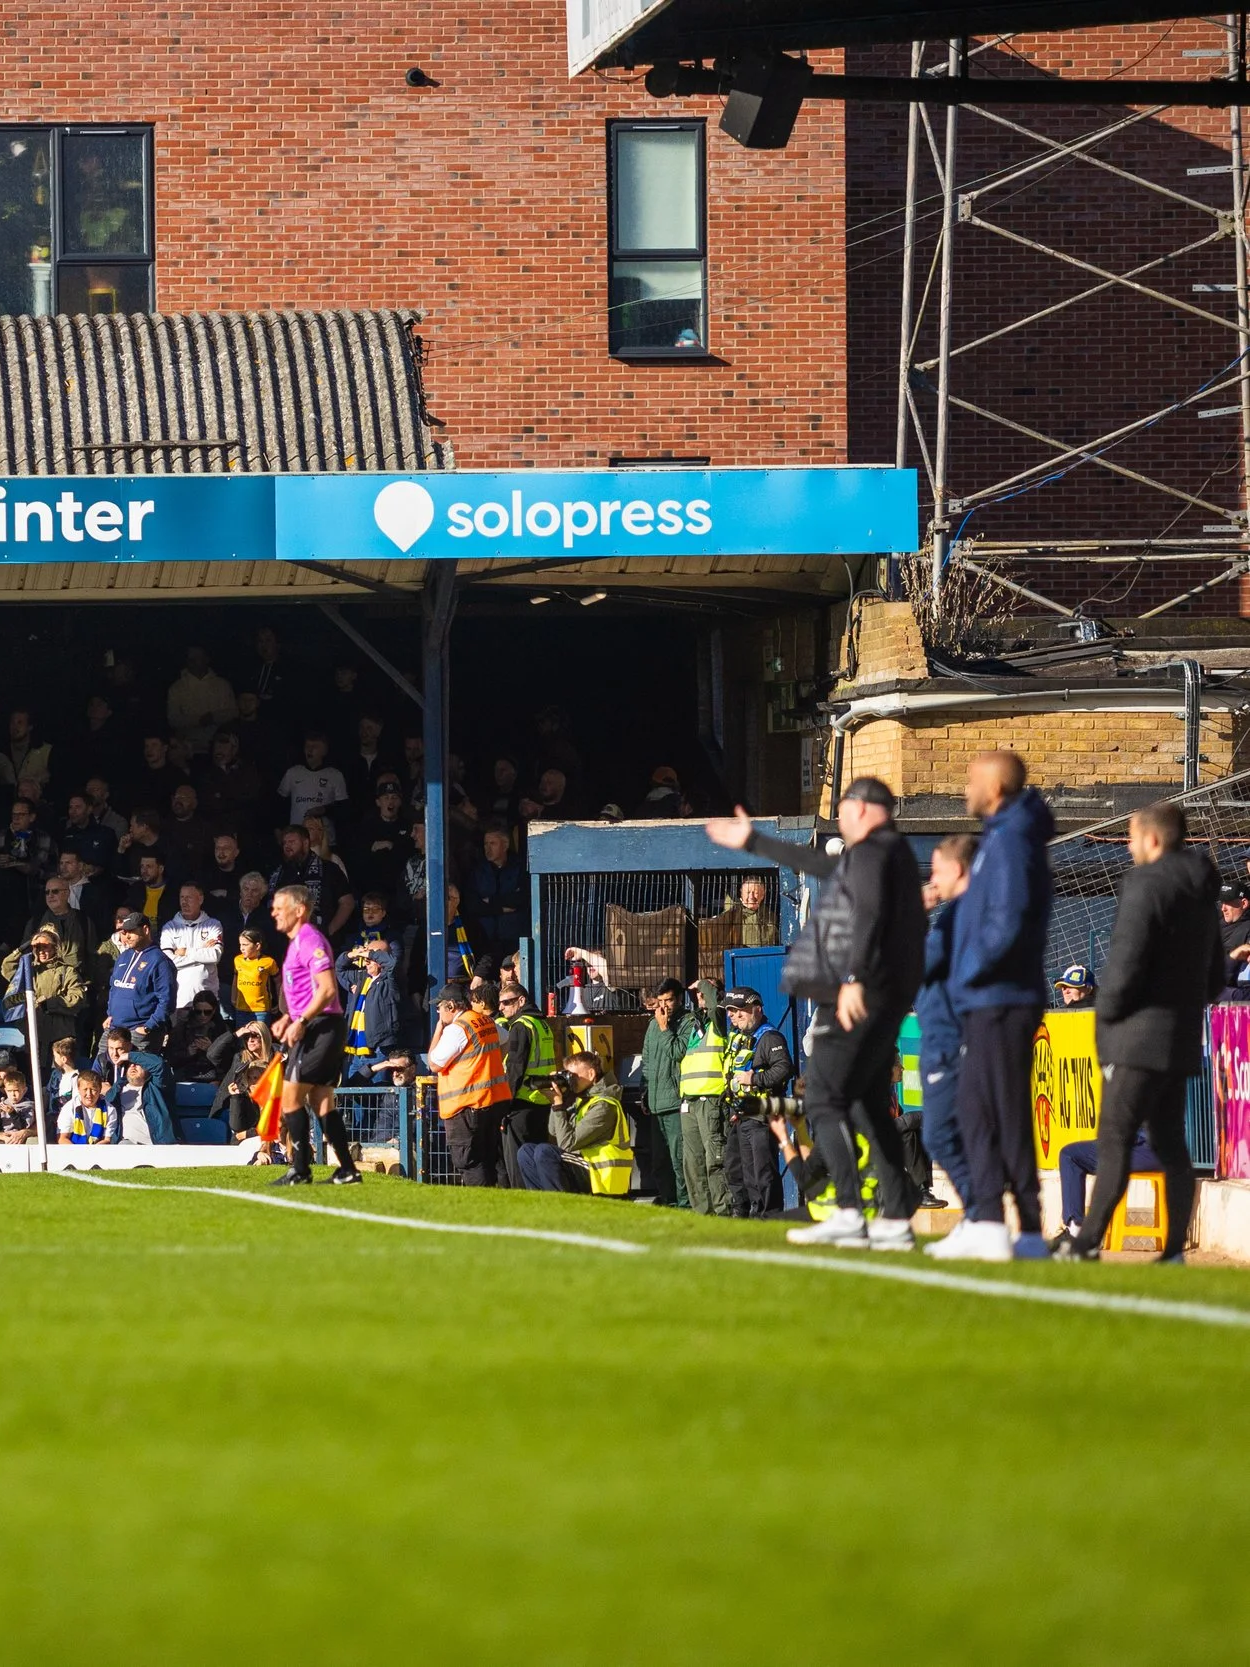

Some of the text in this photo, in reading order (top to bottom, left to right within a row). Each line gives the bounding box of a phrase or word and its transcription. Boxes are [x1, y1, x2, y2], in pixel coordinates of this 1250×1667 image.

[447, 489, 713, 548] solopress
[1059, 1056, 1096, 1129] AC TAXIS
